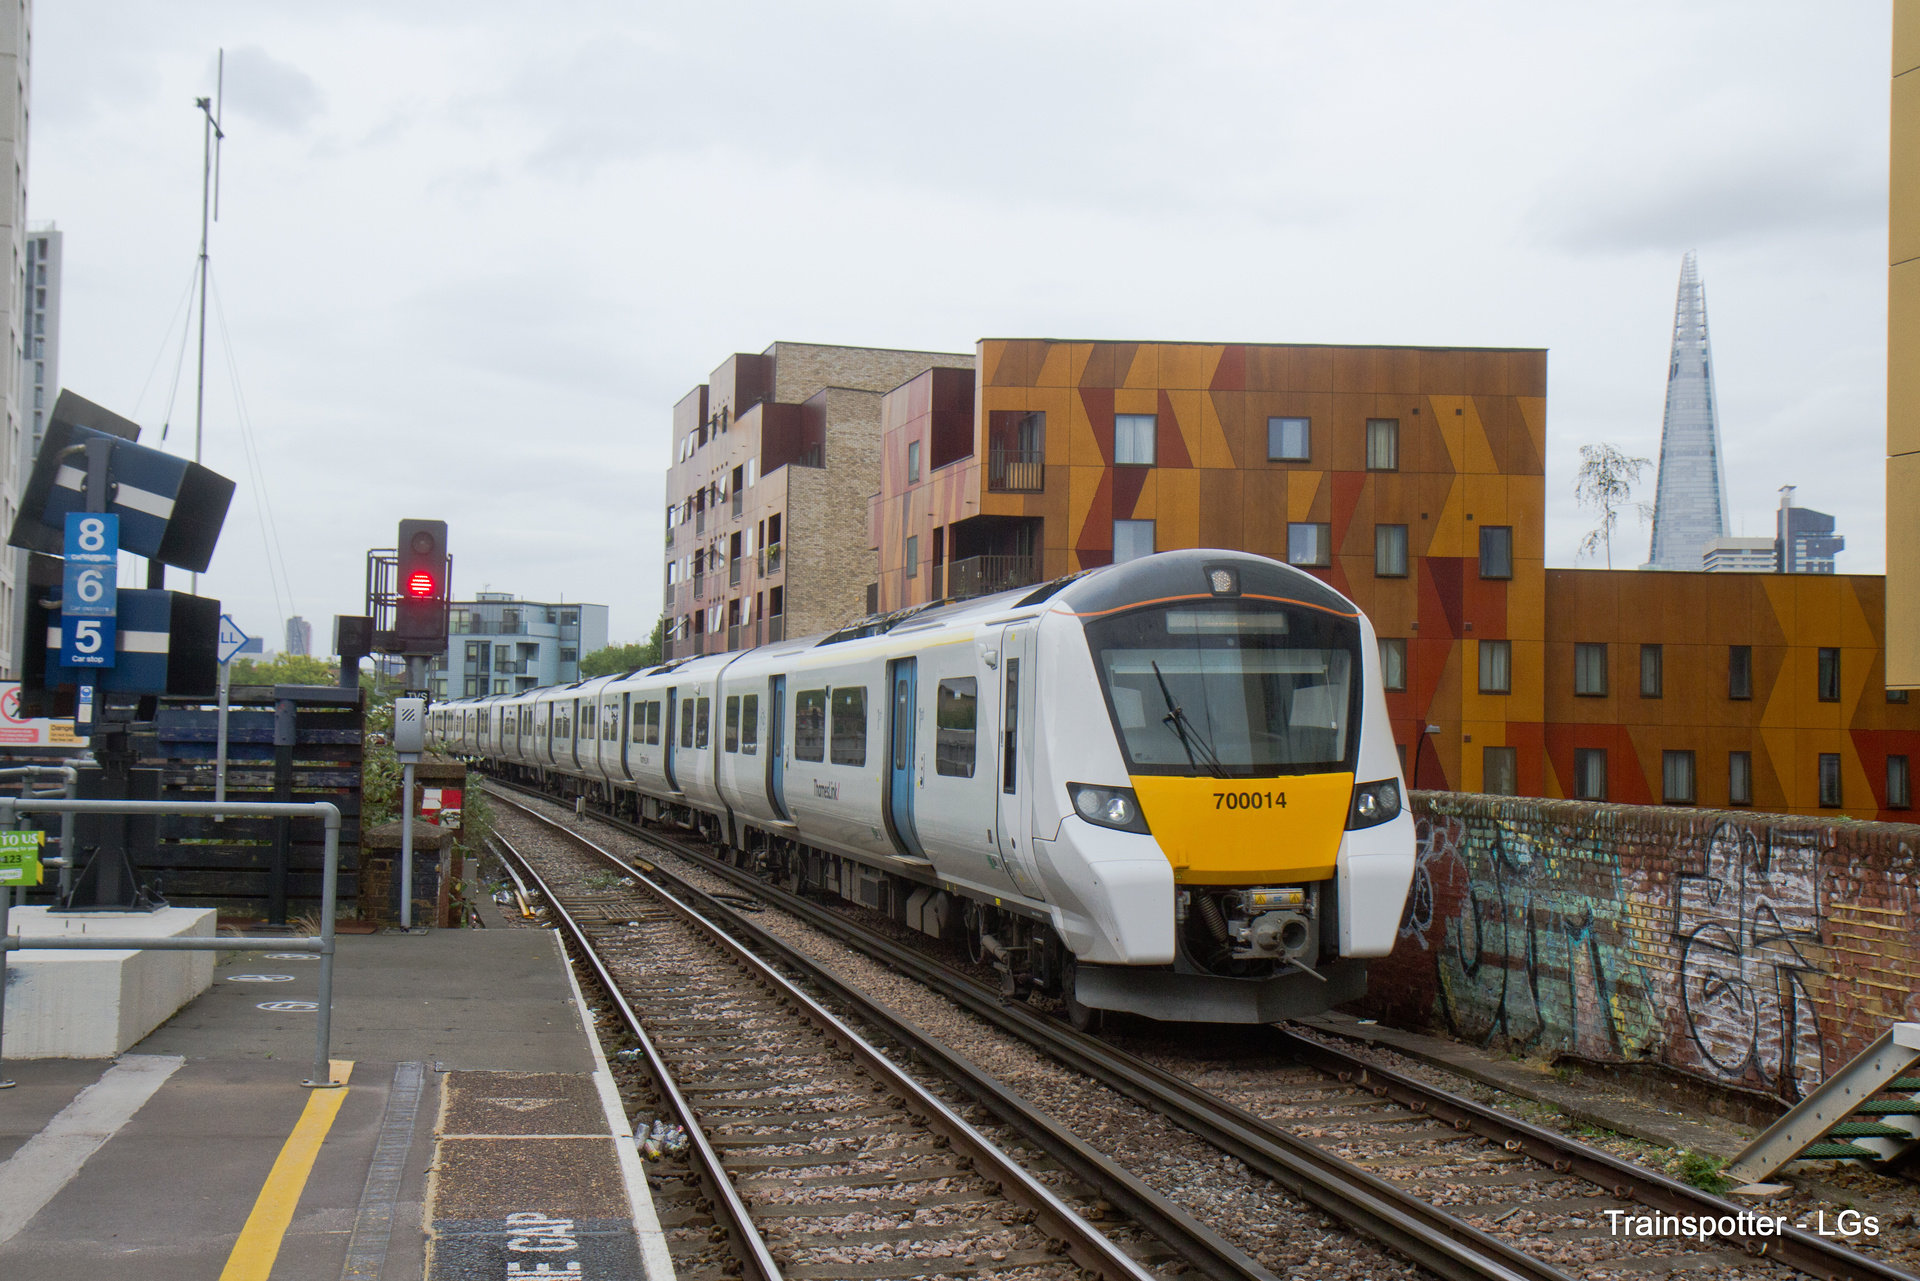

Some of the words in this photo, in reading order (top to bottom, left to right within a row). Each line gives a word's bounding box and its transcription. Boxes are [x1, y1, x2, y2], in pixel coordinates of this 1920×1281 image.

[78, 518, 105, 552] 8
[77, 569, 103, 602] 6
[75, 620, 102, 653] 5
[87, 656, 104, 664] stop
[1213, 791, 1287, 810] 700014
[22, 832, 38, 844] US
